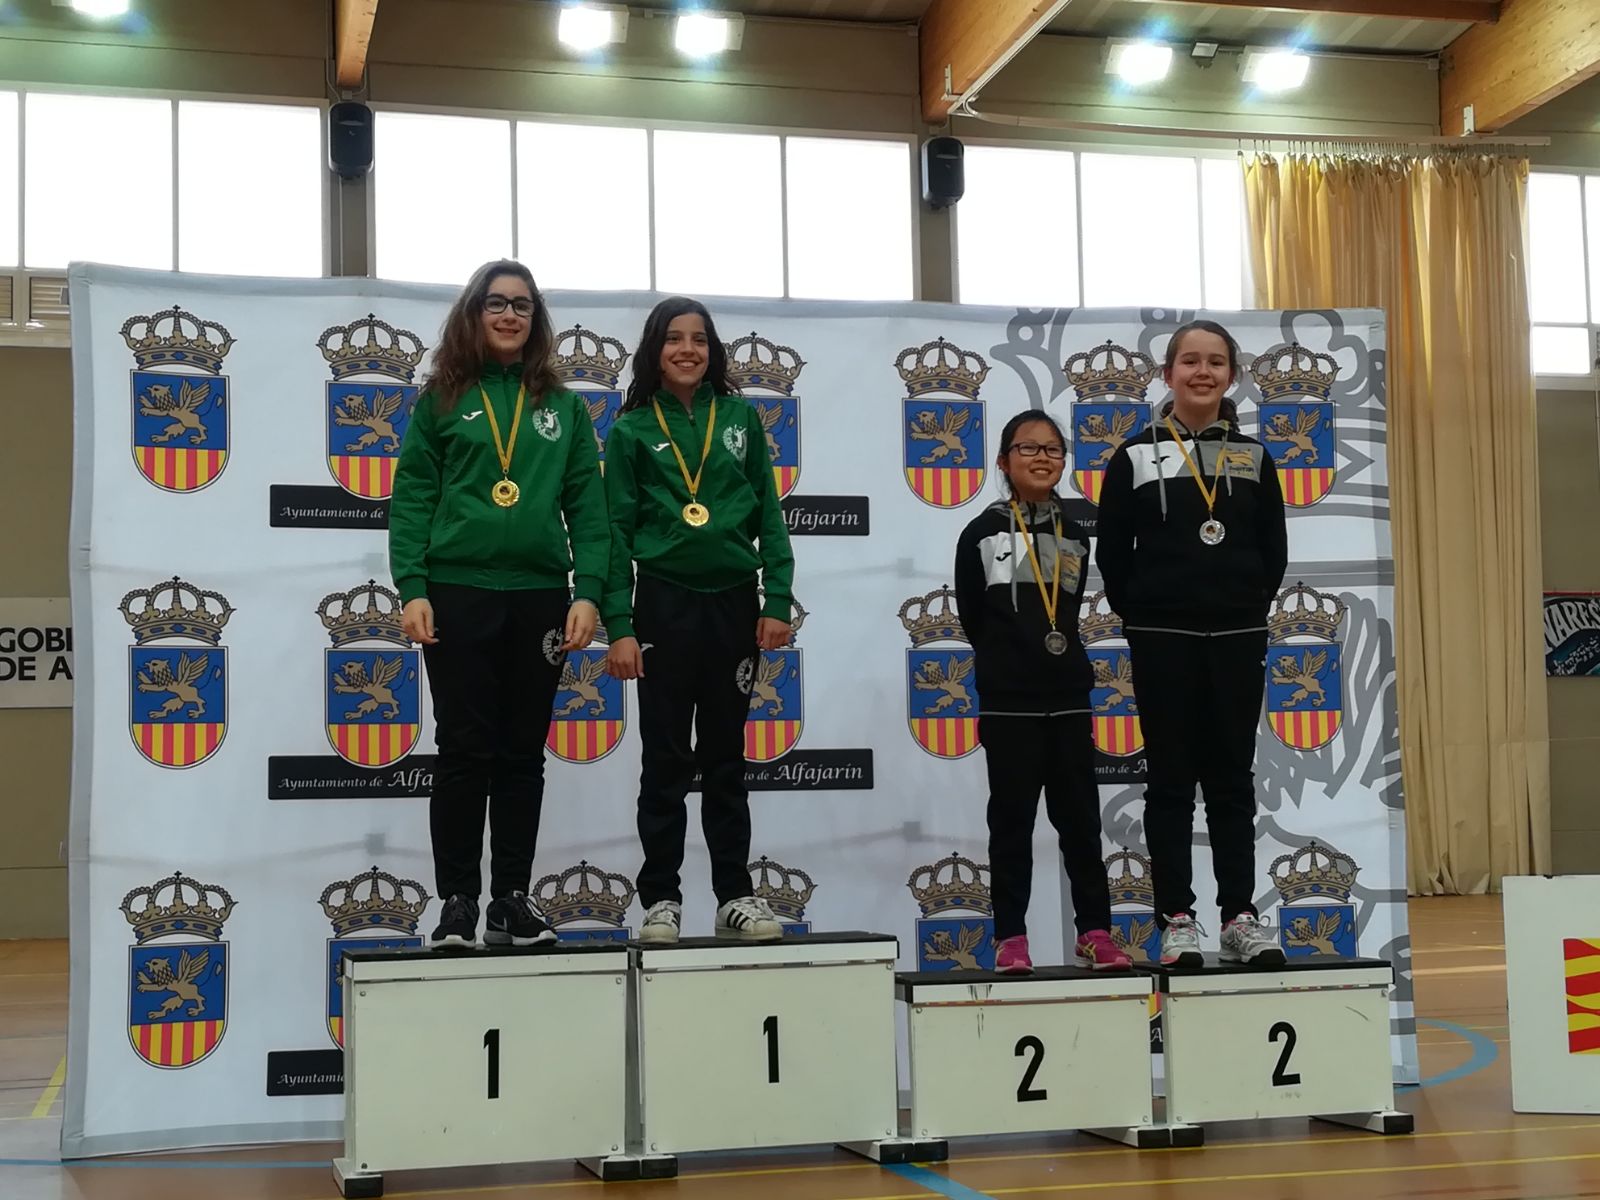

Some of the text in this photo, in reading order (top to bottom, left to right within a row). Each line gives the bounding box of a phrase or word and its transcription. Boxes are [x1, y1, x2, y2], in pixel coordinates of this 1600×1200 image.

[280, 506, 384, 520] Ayuntamiento de
[278, 768, 433, 792] Ayuntamiento de Alfa
[756, 770, 770, 781] de
[484, 1029, 499, 1099] 1
[764, 1016, 779, 1083] 1
[1015, 1036, 1047, 1102] 2
[1269, 1022, 1300, 1086] 2
